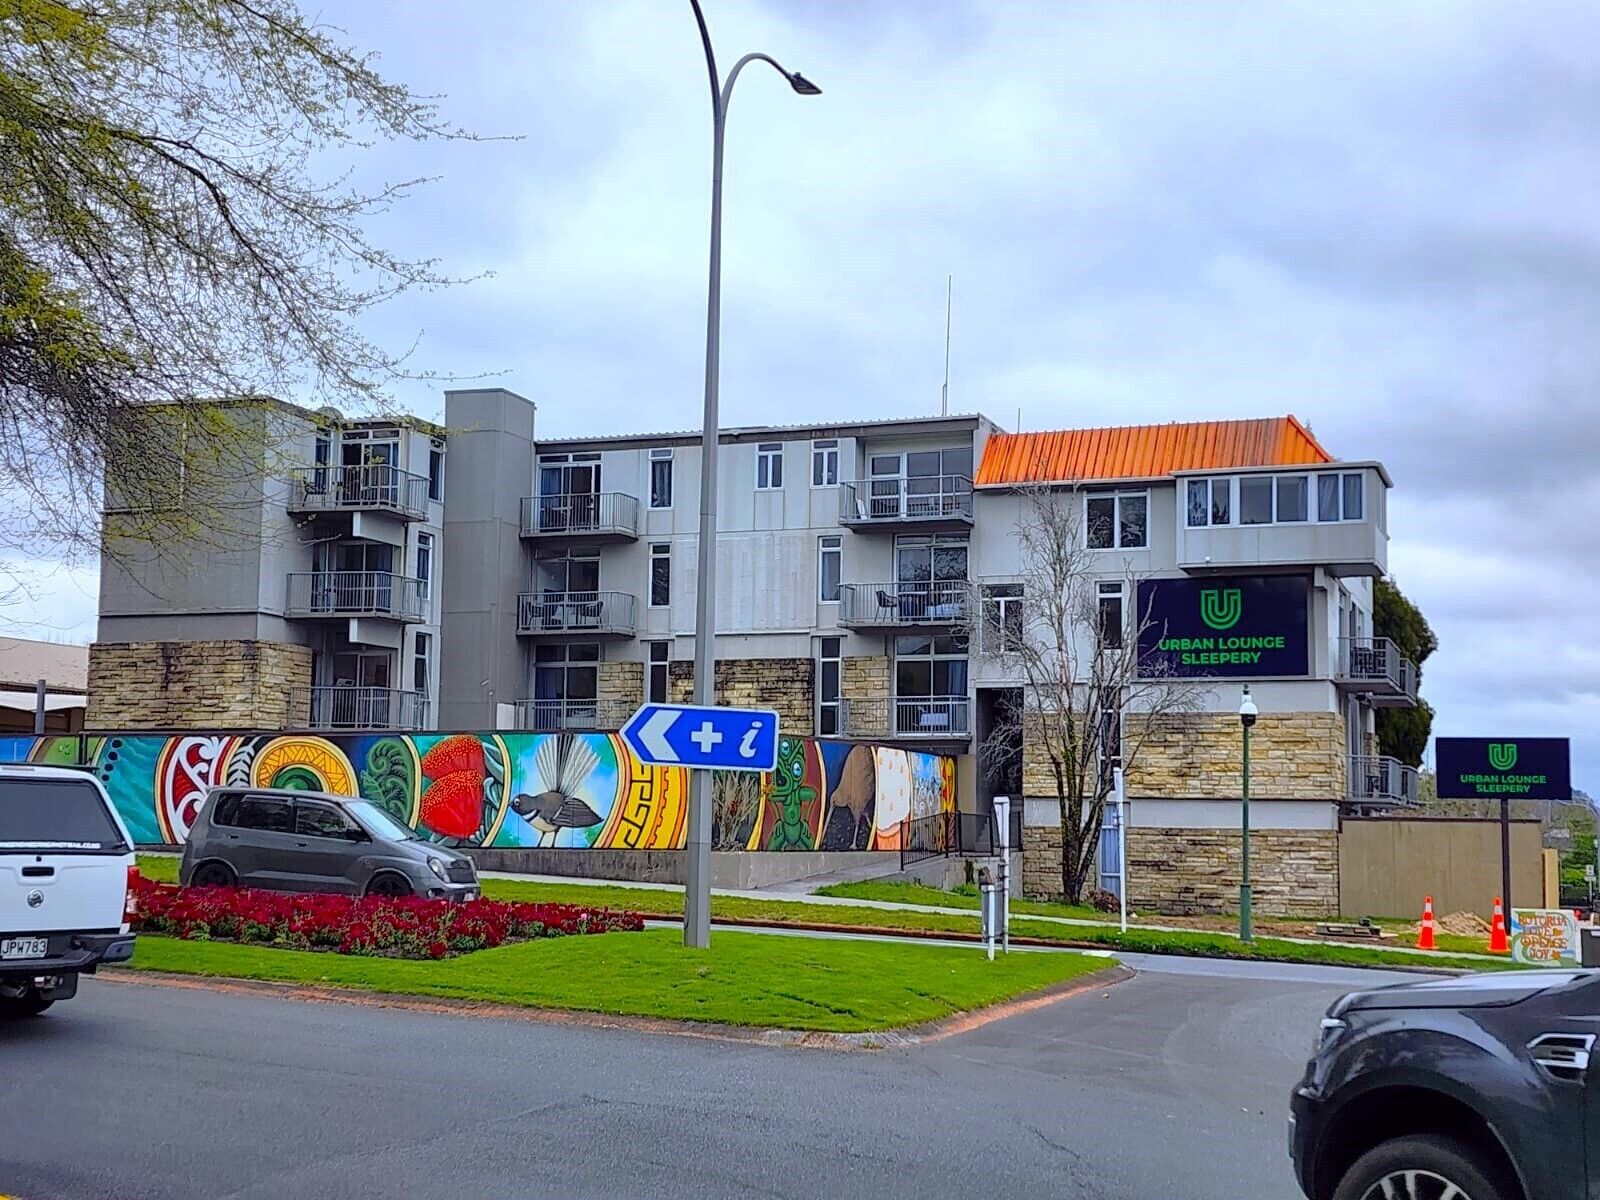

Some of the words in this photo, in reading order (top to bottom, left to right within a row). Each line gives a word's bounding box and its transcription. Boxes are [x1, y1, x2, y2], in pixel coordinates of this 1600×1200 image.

[1158, 638, 1214, 650] URBAN
[1219, 636, 1286, 649] LOUNGE
[1181, 652, 1262, 665] SLEEPERY
[1460, 774, 1498, 783] URBAN
[1501, 775, 1547, 784] LOUNGE
[1475, 784, 1531, 793] SLEEPERY
[2, 940, 46, 954] JPW783
[1529, 947, 1549, 959] JOY
